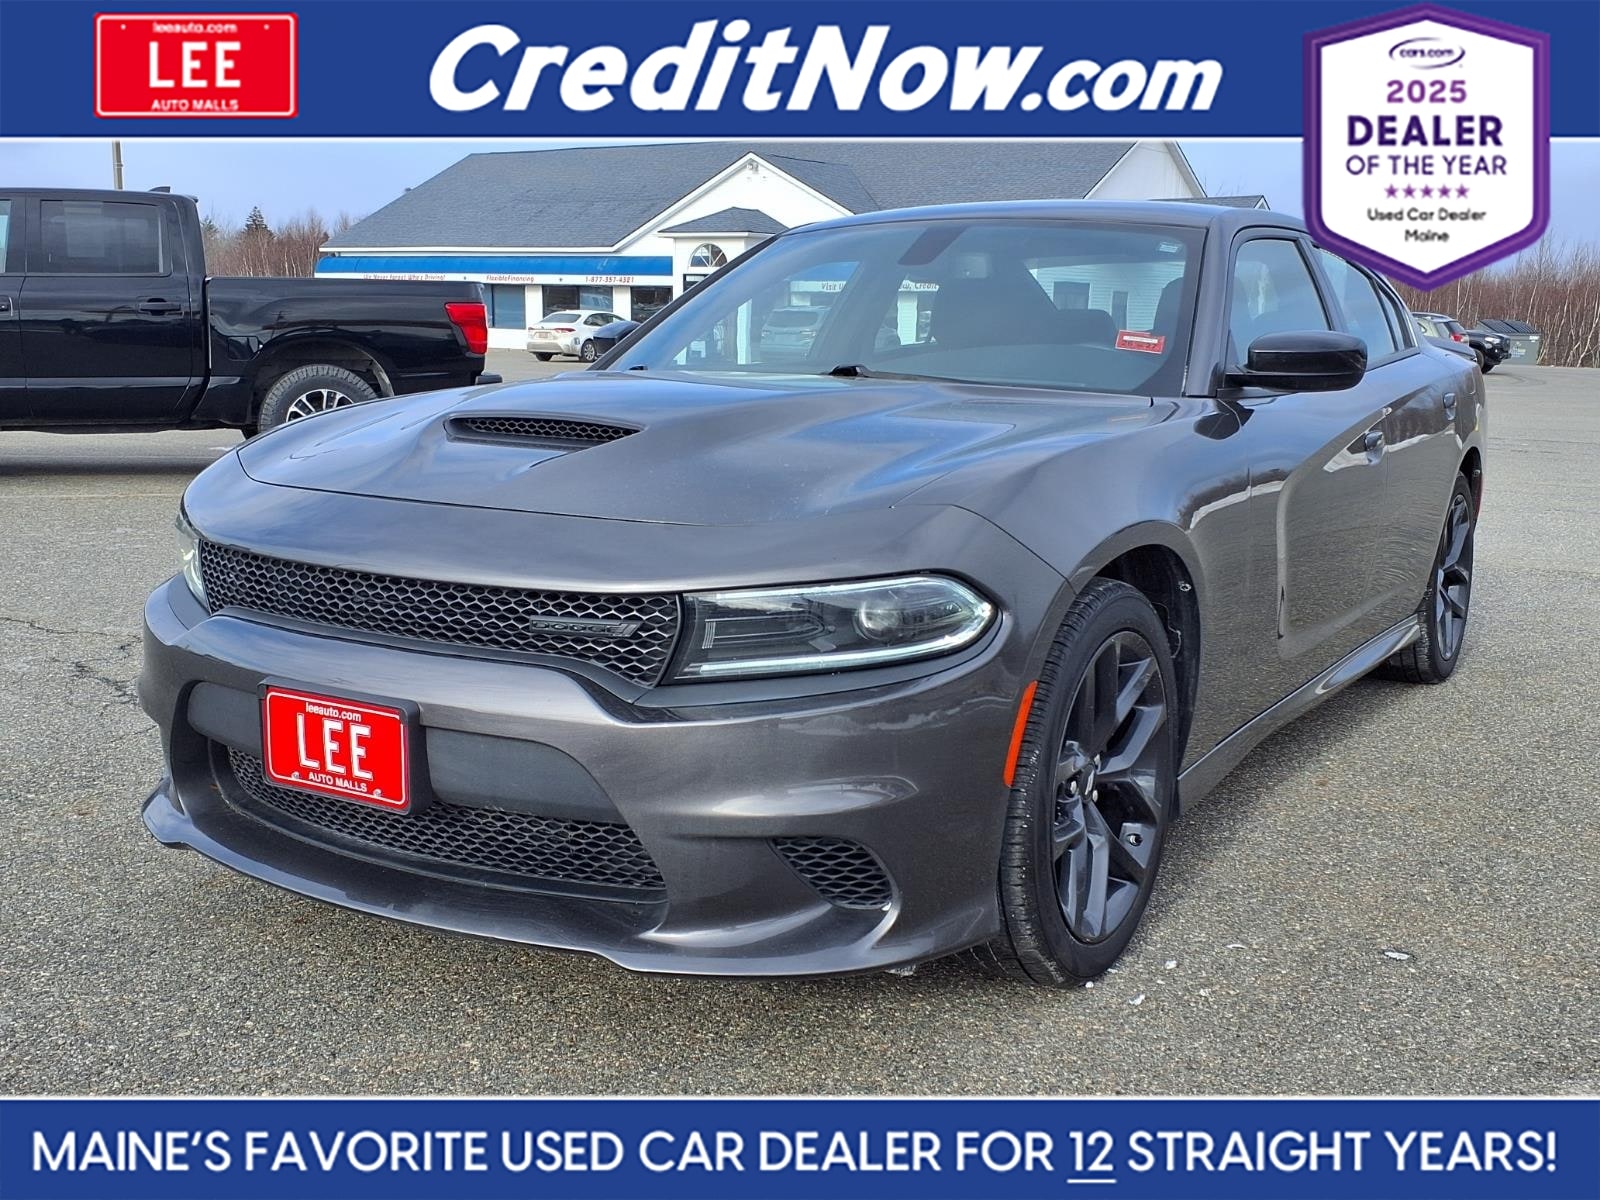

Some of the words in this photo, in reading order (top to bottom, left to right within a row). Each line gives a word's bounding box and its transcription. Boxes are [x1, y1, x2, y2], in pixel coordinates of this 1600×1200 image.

[306, 702, 361, 722] leeauto.com
[296, 712, 374, 781] LEE
[308, 771, 334, 786] AUTO
[335, 777, 367, 793] MALLS
